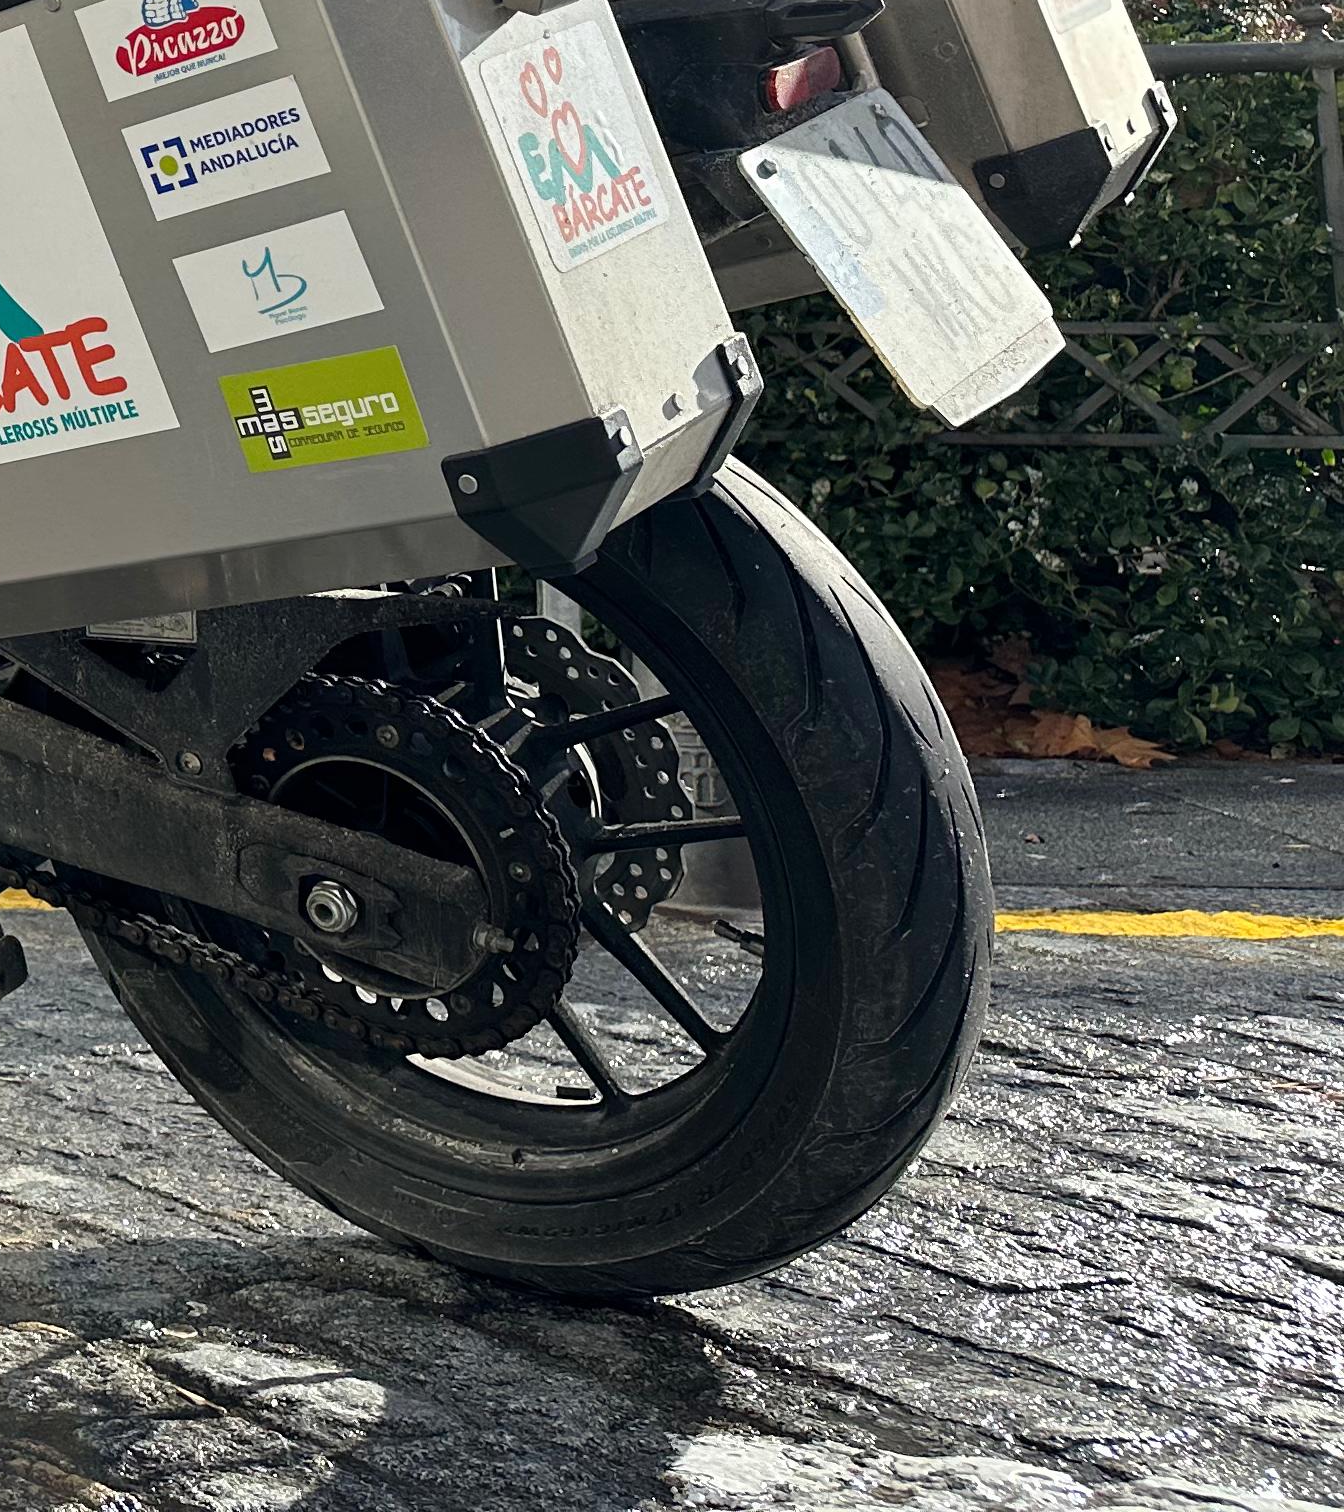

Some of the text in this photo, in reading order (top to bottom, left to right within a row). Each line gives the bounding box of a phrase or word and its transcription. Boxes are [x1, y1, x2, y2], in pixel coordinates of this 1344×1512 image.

[125, 14, 241, 77] Picazzo
[189, 108, 300, 153] MEDIADORES
[200, 133, 299, 175] ANDALUCÍA
[552, 166, 651, 244] BÁRCATE
[60, 399, 139, 431] MÚLTIPLE
[302, 392, 399, 426] seguro
